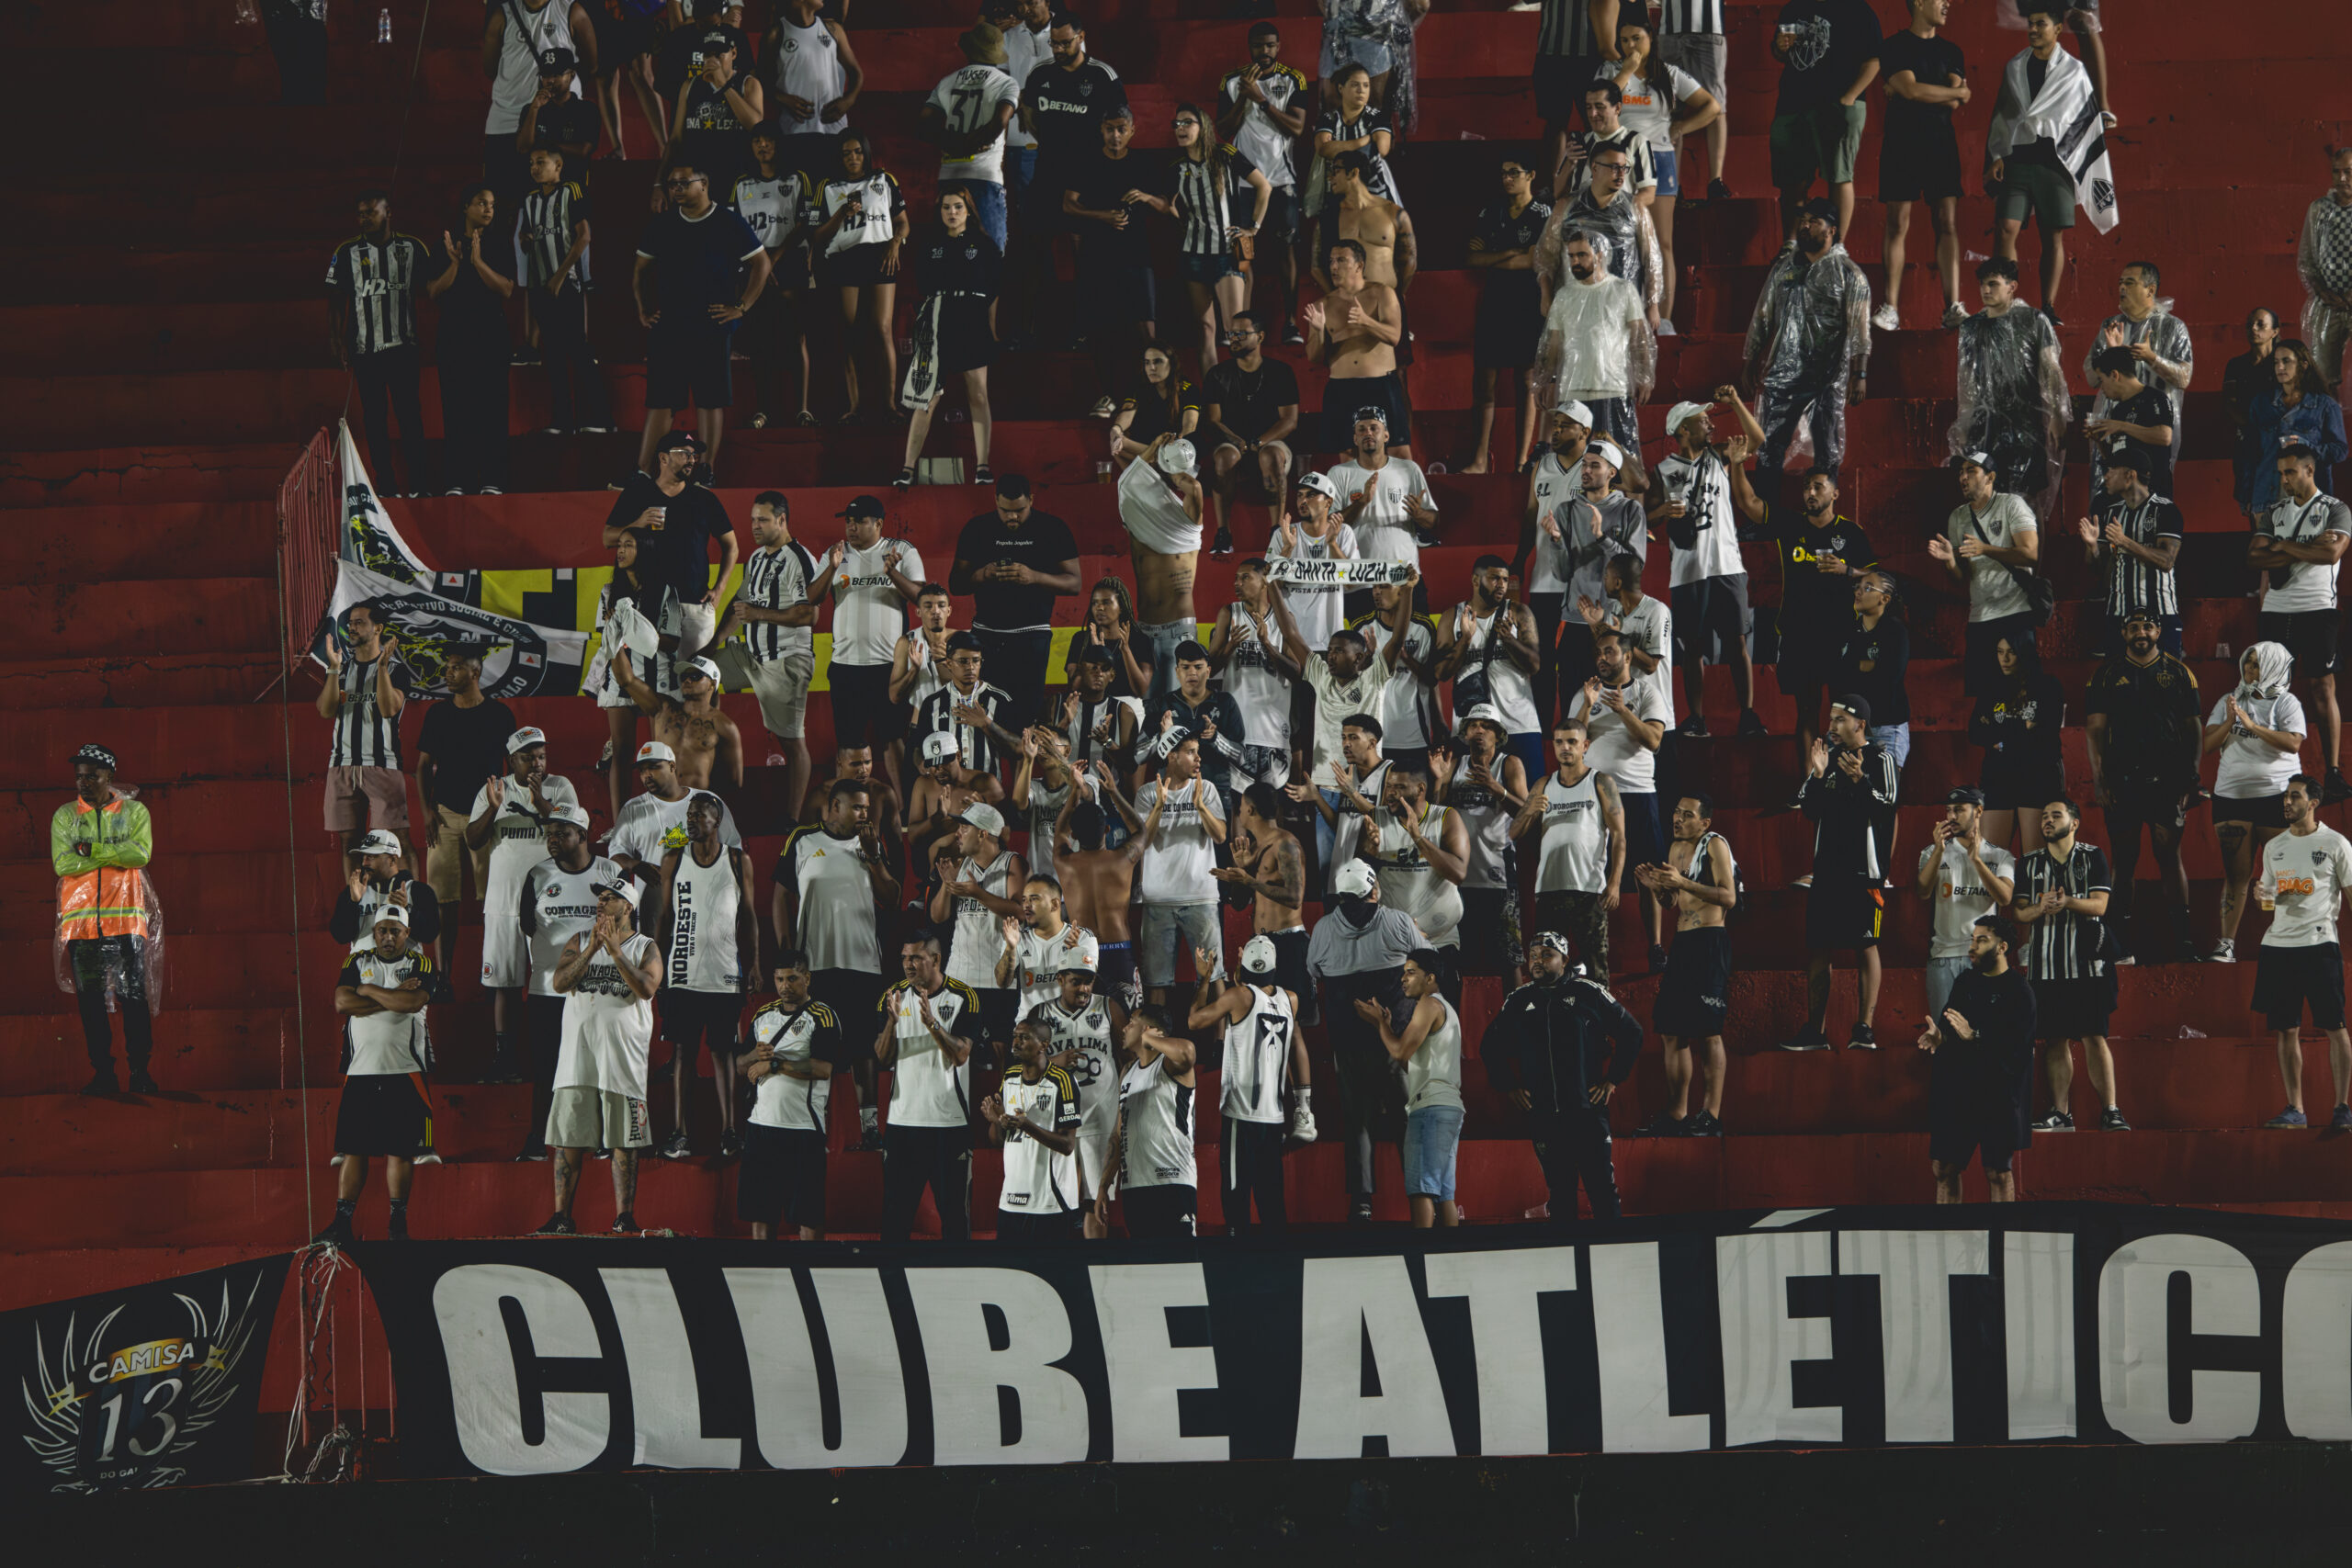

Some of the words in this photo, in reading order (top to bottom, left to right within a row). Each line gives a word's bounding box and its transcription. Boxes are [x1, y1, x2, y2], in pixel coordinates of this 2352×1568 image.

[956, 71, 991, 84] MUGEN
[950, 89, 984, 134] 37
[1049, 101, 1088, 114] BETANO
[501, 827, 537, 840] PUMA
[2277, 877, 2315, 896] BMG
[545, 906, 599, 916] CONTAGE
[671, 881, 692, 986] NOROESTE
[1079, 1036, 1109, 1055] LIMA
[89, 1341, 196, 1384] CAMISA
[432, 1262, 1230, 1476] CLUBE
[96, 1378, 184, 1463] 13
[99, 1471, 117, 1480] DO
